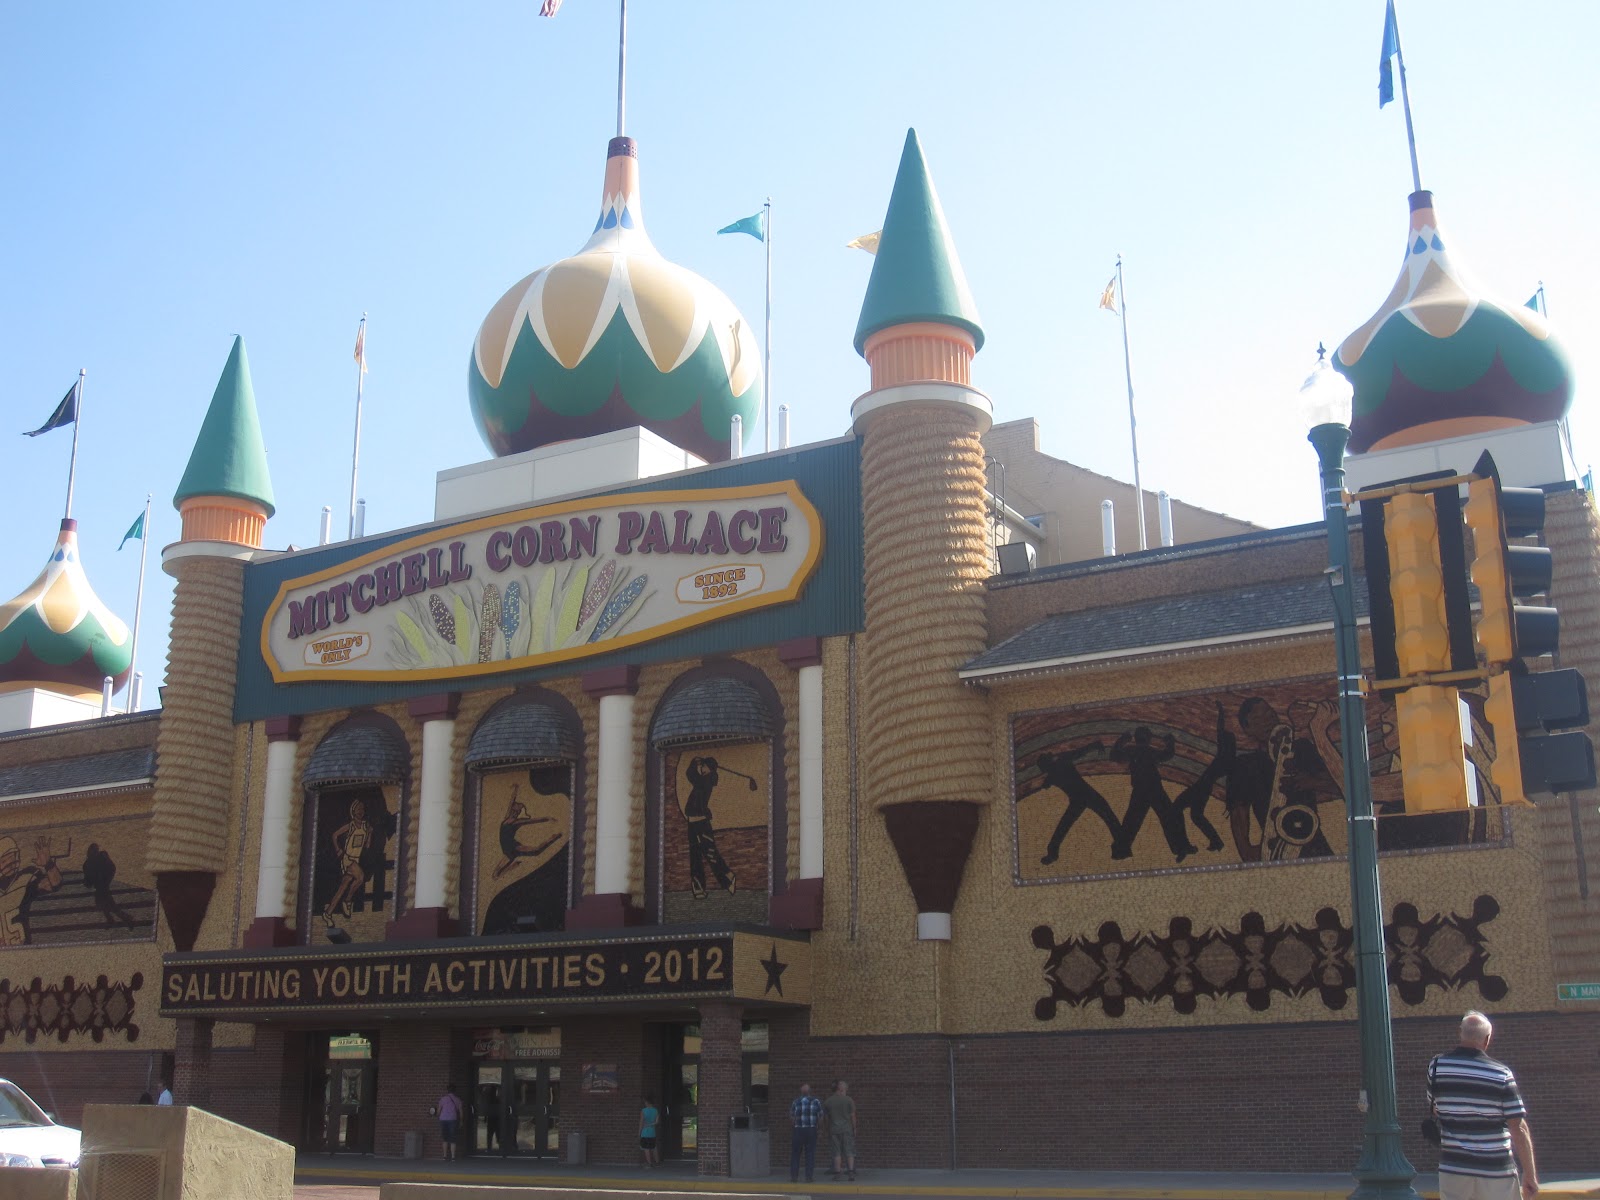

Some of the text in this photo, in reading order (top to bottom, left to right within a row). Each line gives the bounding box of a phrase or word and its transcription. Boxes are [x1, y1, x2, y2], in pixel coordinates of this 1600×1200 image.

[287, 507, 788, 639] MITCHELL CORN PALACE
[695, 568, 745, 588] SINCE
[702, 583, 737, 599] 1892
[312, 635, 363, 654] WORLD'S
[321, 649, 351, 663] ONLY
[168, 947, 724, 1001] SALUTING YOUTH ACTIVITIES 2012
[1570, 986, 1577, 997] N
[515, 1048, 531, 1057] FREE
